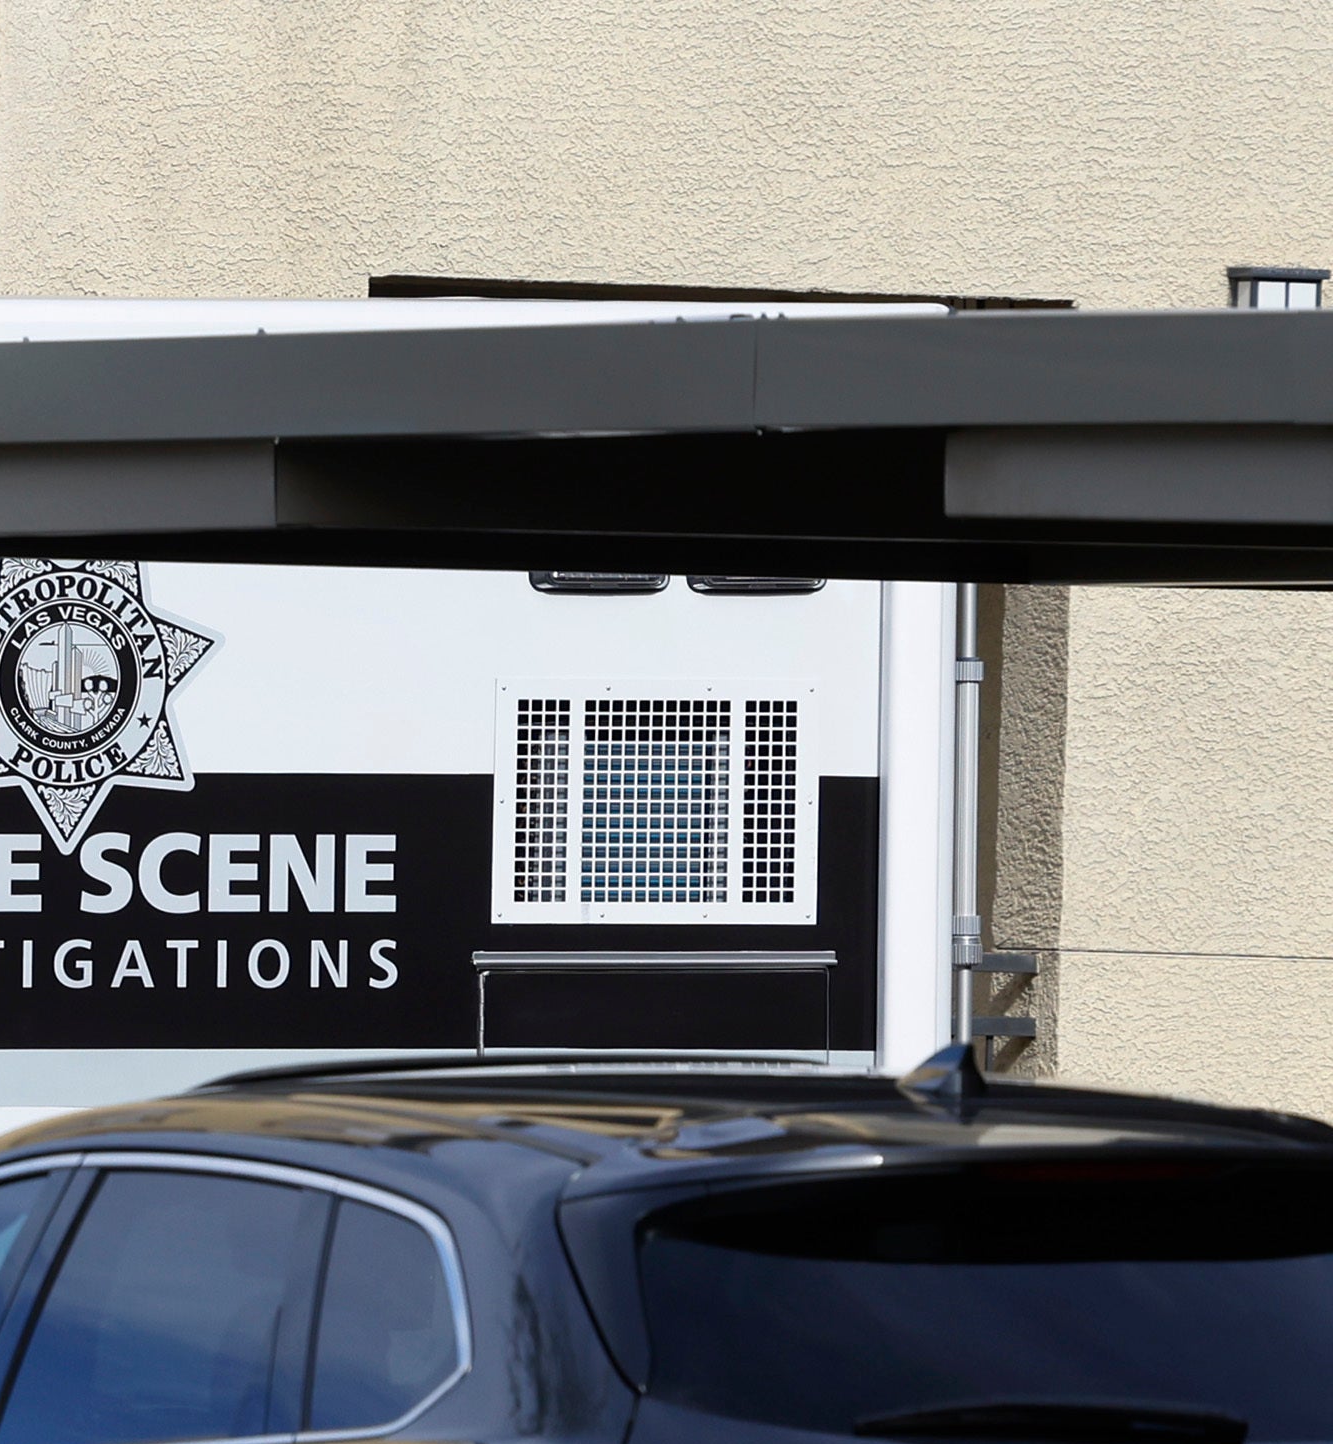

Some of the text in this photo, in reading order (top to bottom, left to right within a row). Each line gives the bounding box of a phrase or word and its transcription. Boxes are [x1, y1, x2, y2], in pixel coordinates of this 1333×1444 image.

[10, 606, 127, 651] LAS VEGAS
[10, 707, 40, 740] CLARK
[91, 707, 126, 744] NEVADA
[9, 741, 128, 784] POLICE
[80, 832, 397, 914] SCENE
